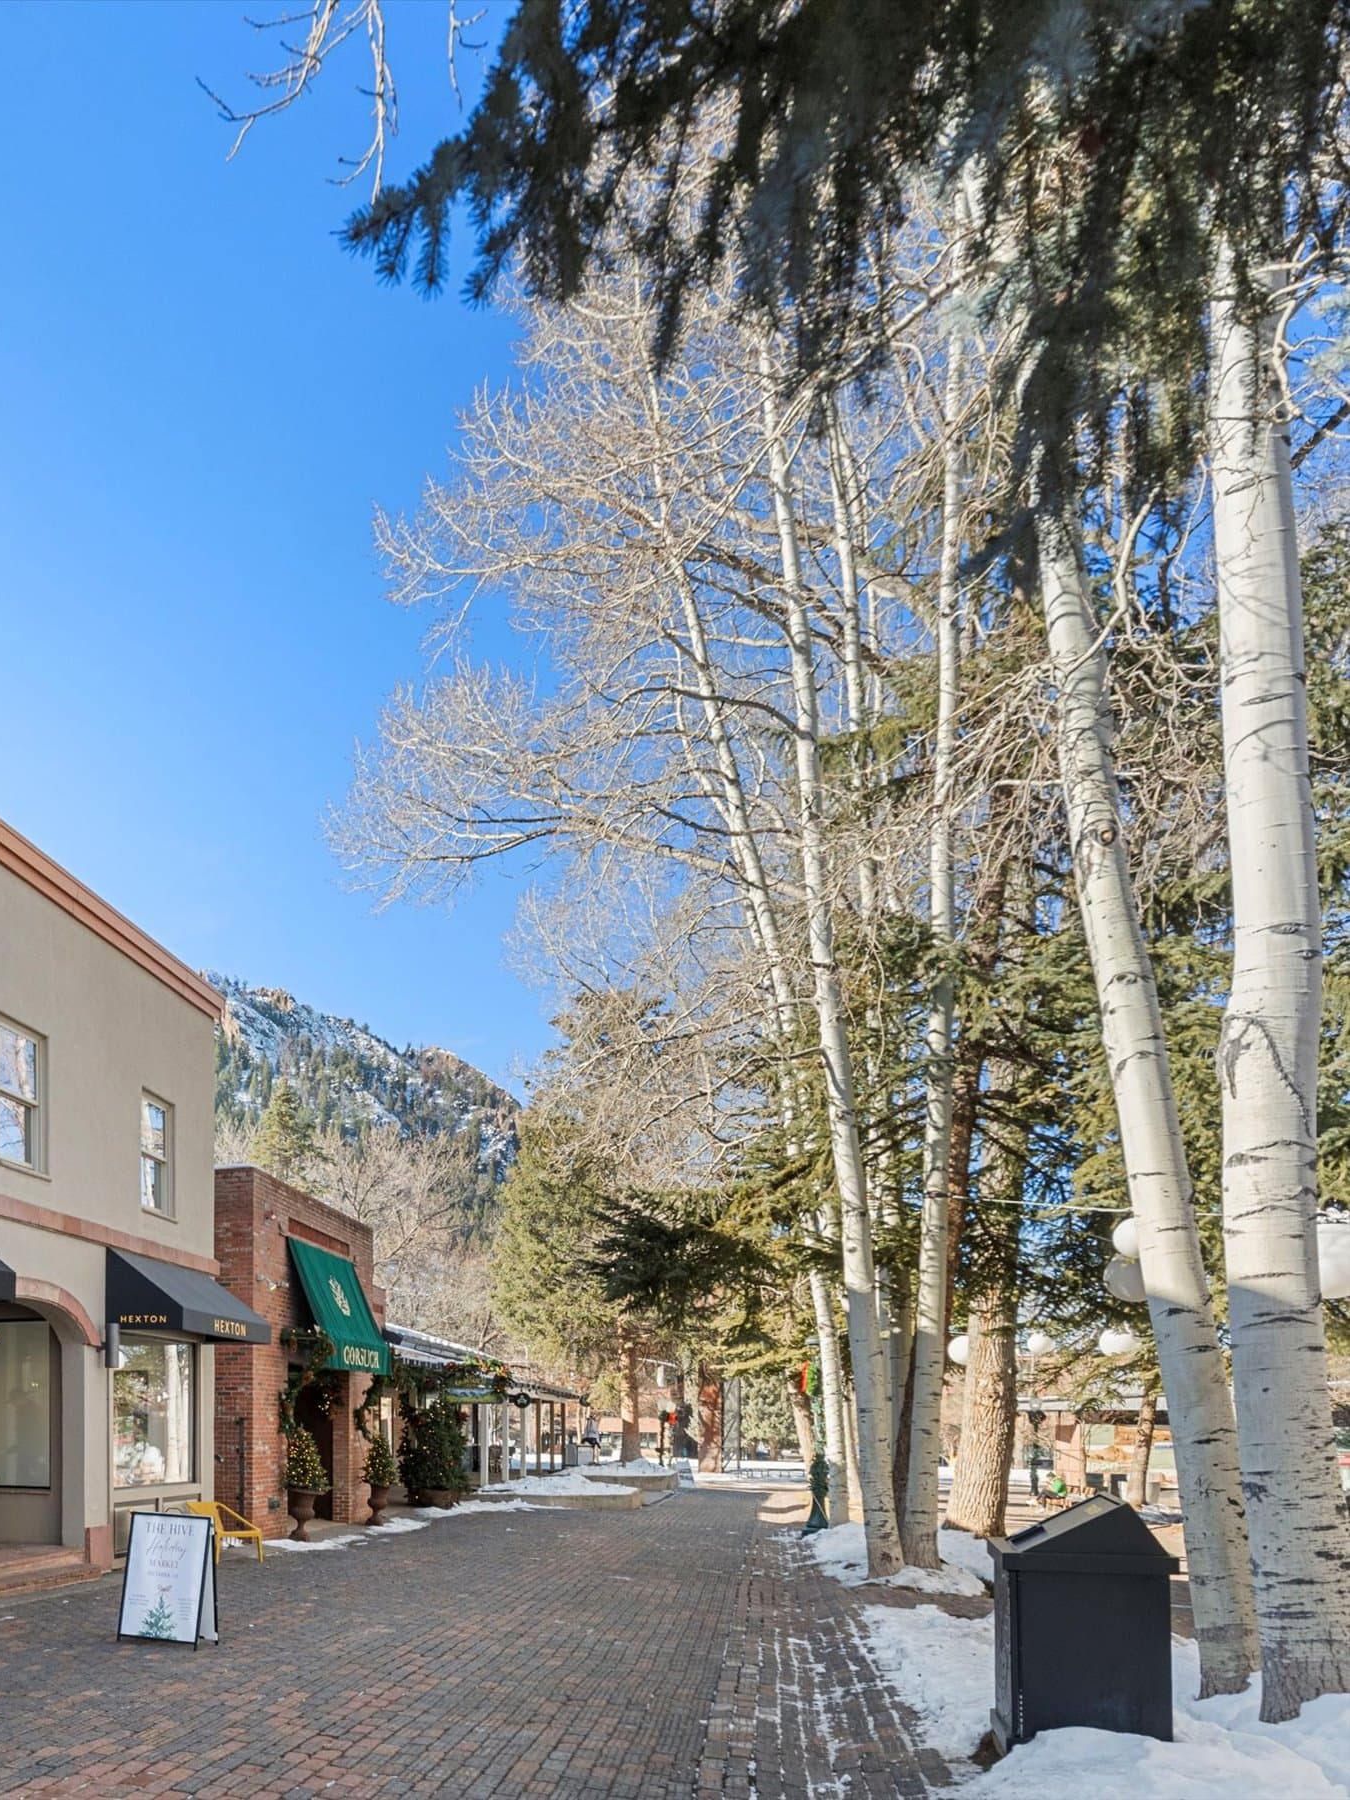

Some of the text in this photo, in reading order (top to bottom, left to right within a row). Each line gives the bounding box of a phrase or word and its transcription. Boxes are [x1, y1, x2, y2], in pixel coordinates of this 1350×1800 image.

[120, 1315, 167, 1324] HEXTON
[214, 1319, 247, 1337] HEXTON
[146, 1522, 195, 1537] THE HIVE
